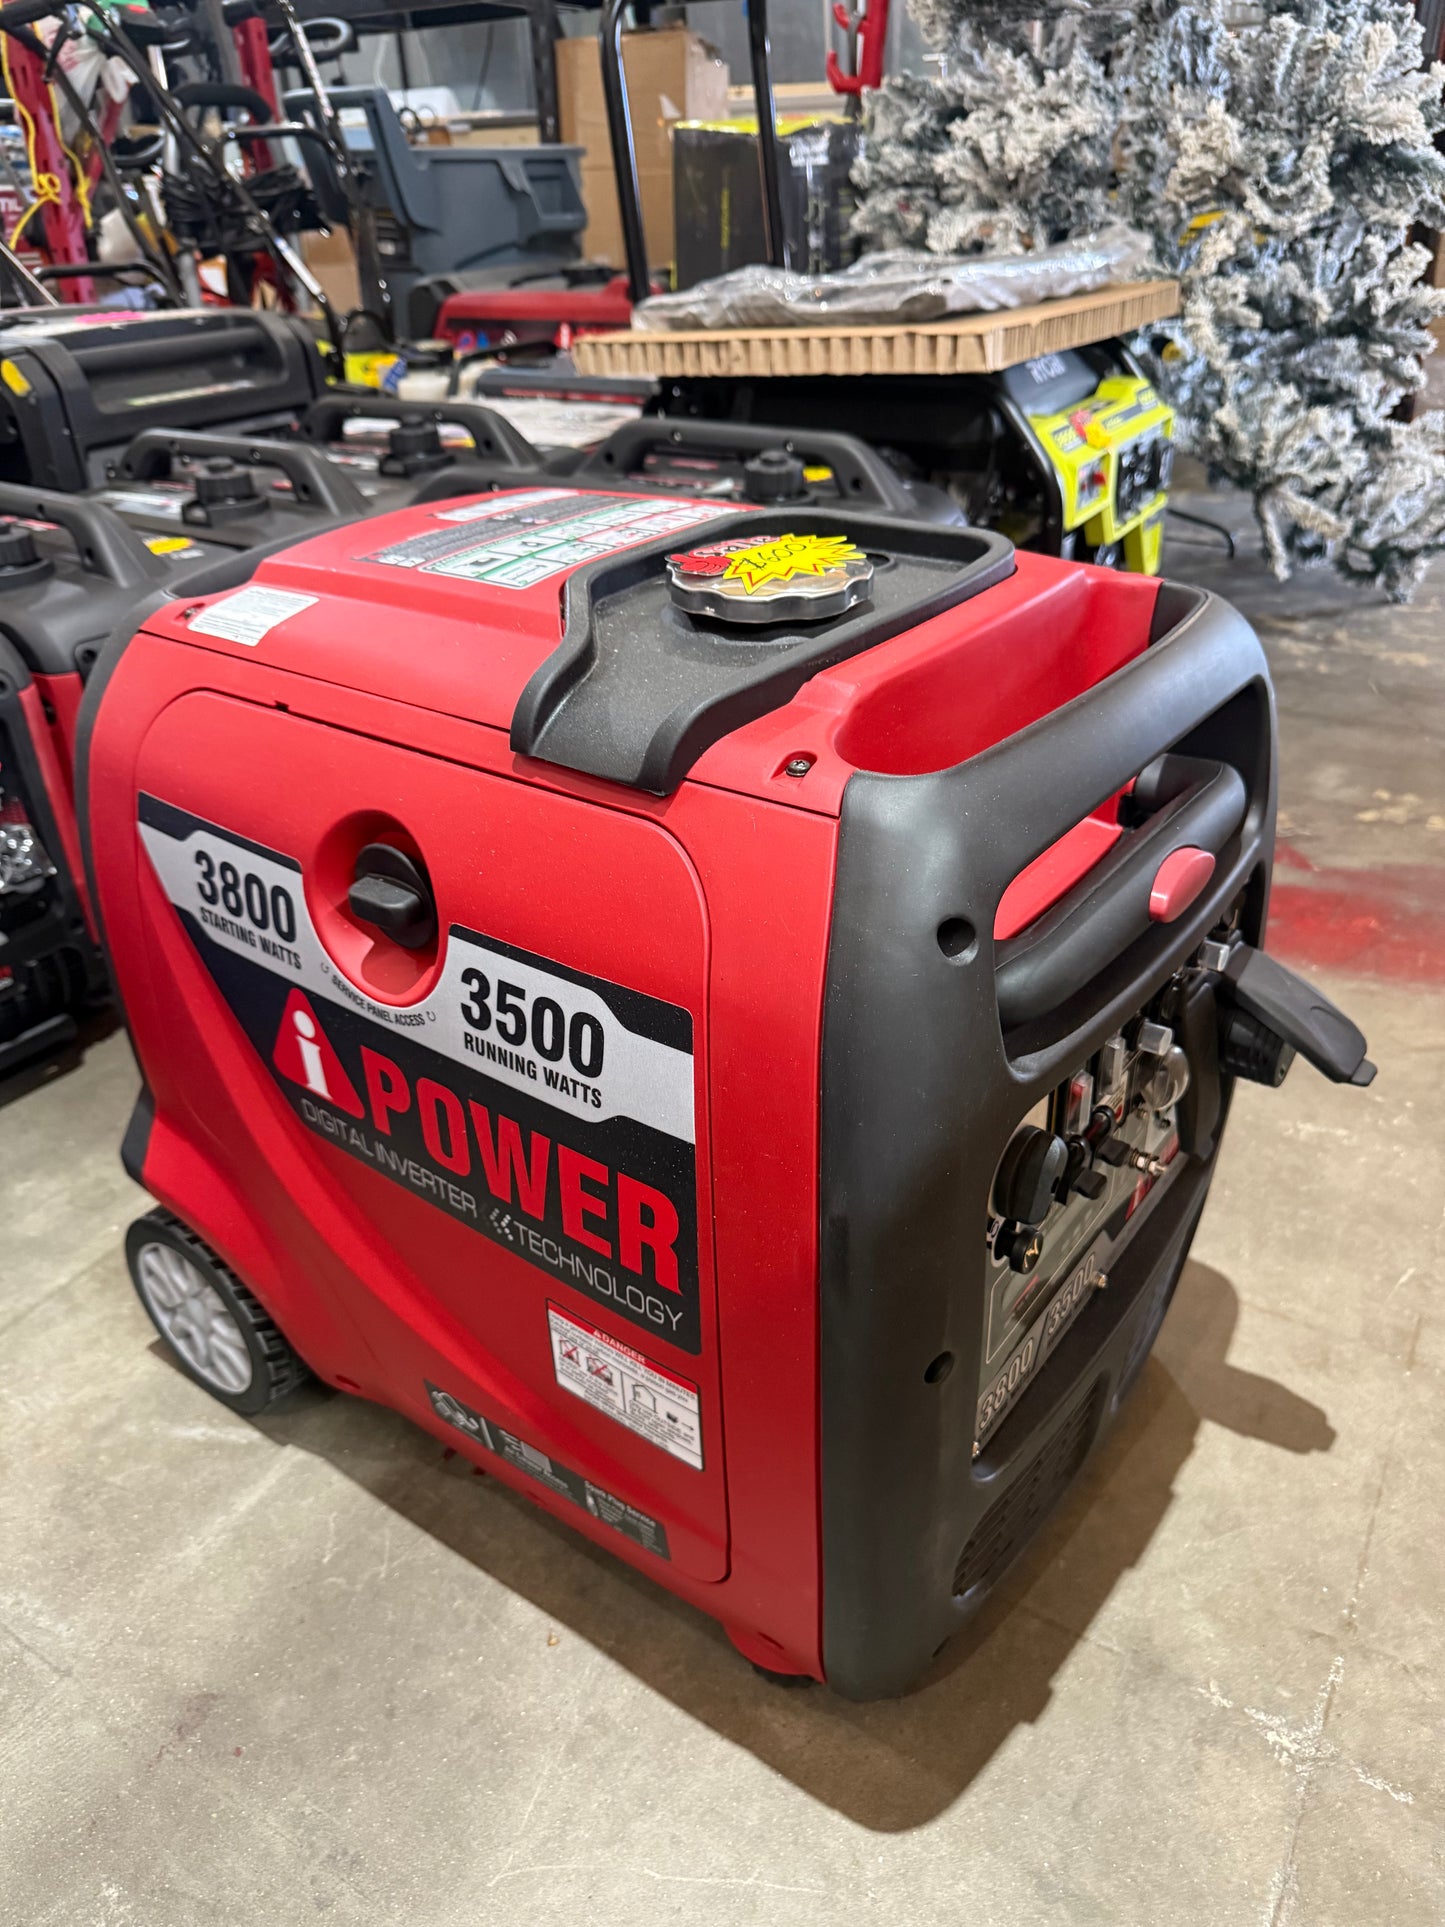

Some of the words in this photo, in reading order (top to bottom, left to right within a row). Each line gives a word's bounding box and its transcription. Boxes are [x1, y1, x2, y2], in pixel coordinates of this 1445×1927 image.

[195, 850, 296, 943] 3800
[200, 907, 257, 948] STARTING
[259, 935, 302, 970] WATTS
[332, 975, 366, 1009] SERVICE
[367, 1003, 394, 1023] PANEL
[394, 1014, 426, 1027] ACCESS
[461, 967, 604, 1079] 3500
[464, 1032, 537, 1081] RUNNING
[544, 1066, 602, 1109] WATTS
[301, 1099, 374, 1156] DIGITAL
[377, 1140, 478, 1218] INVERTER
[513, 1221, 683, 1332] TECHNOLOGY
[1048, 1252, 1095, 1336] 3500
[602, 1333, 646, 1364] DANGER
[979, 1337, 1034, 1430] 3800
